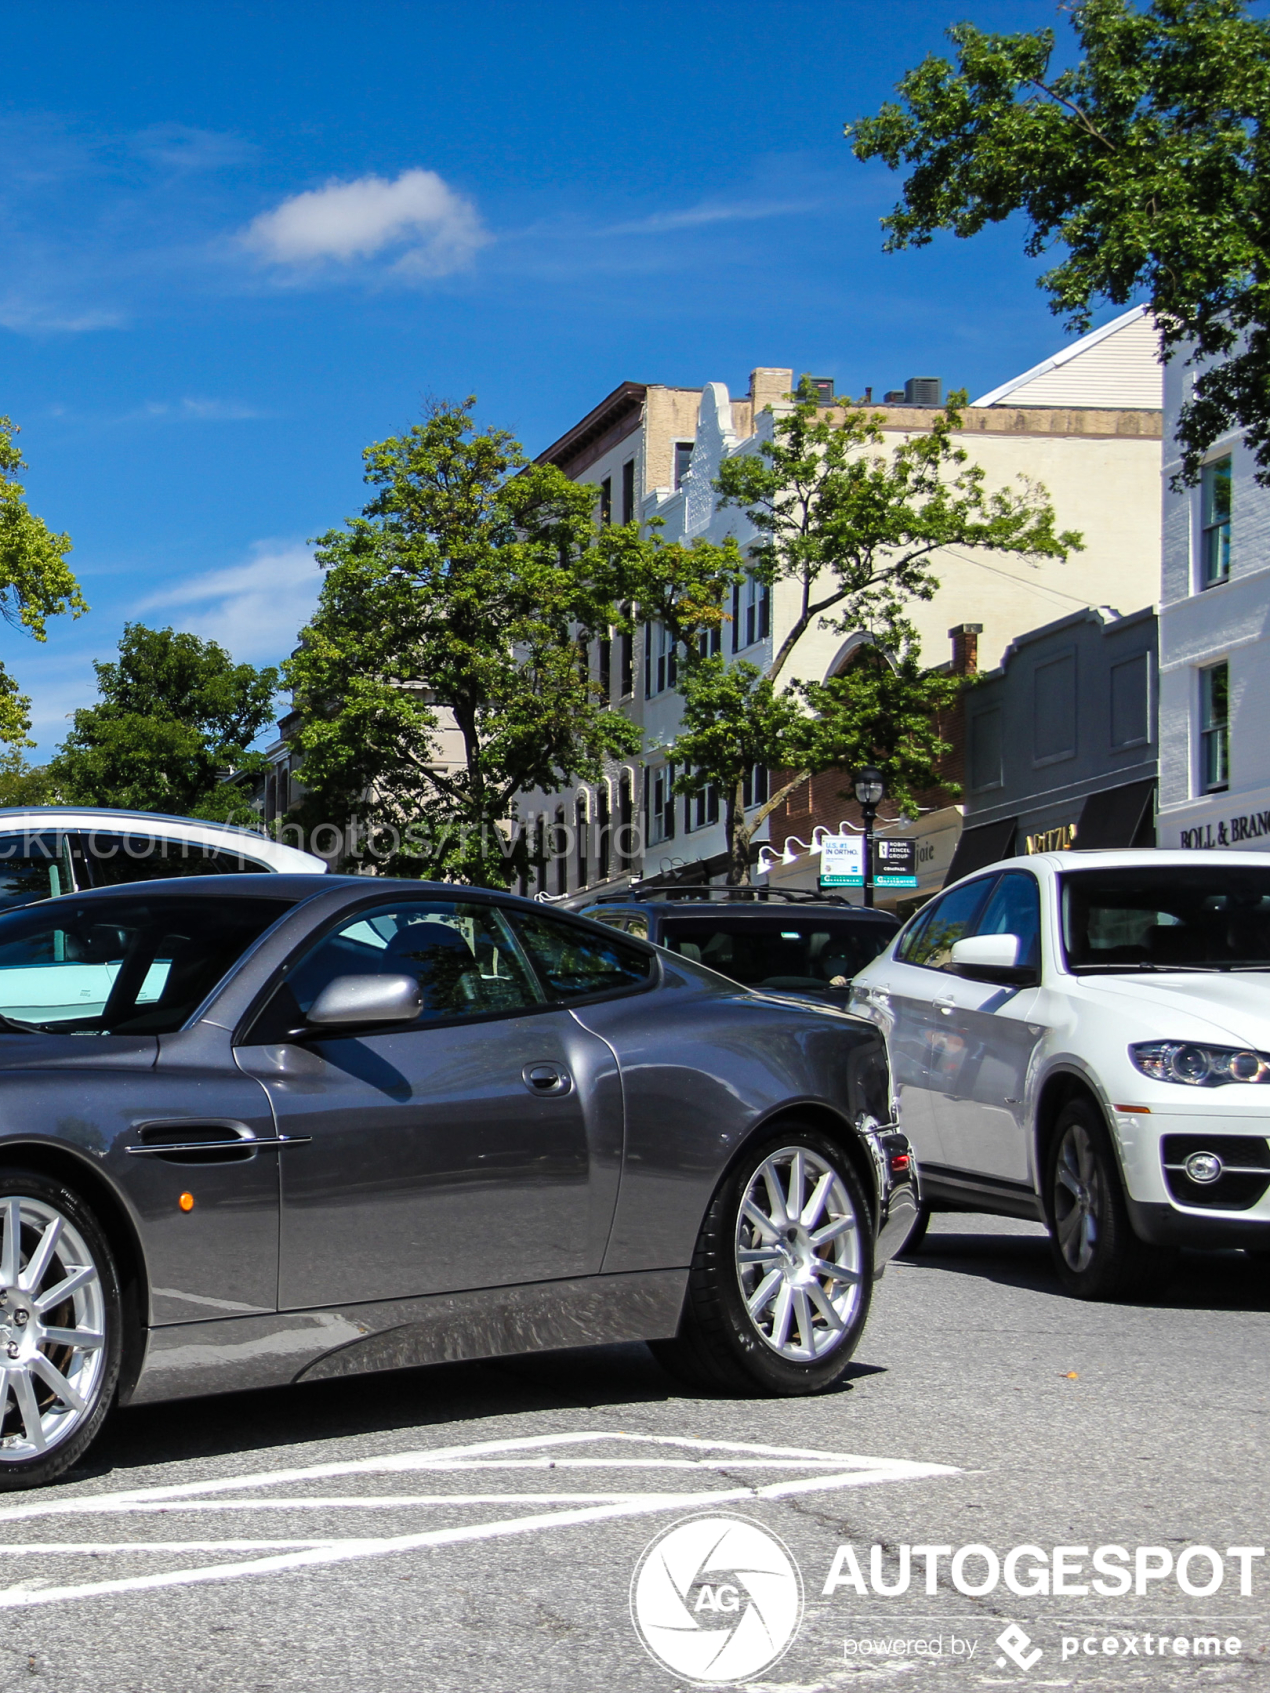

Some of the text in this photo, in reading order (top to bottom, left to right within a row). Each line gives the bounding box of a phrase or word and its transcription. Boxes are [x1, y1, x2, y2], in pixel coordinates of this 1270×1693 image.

[1180, 811, 1270, 848] BOLL & BRAN
[915, 841, 934, 871] joie
